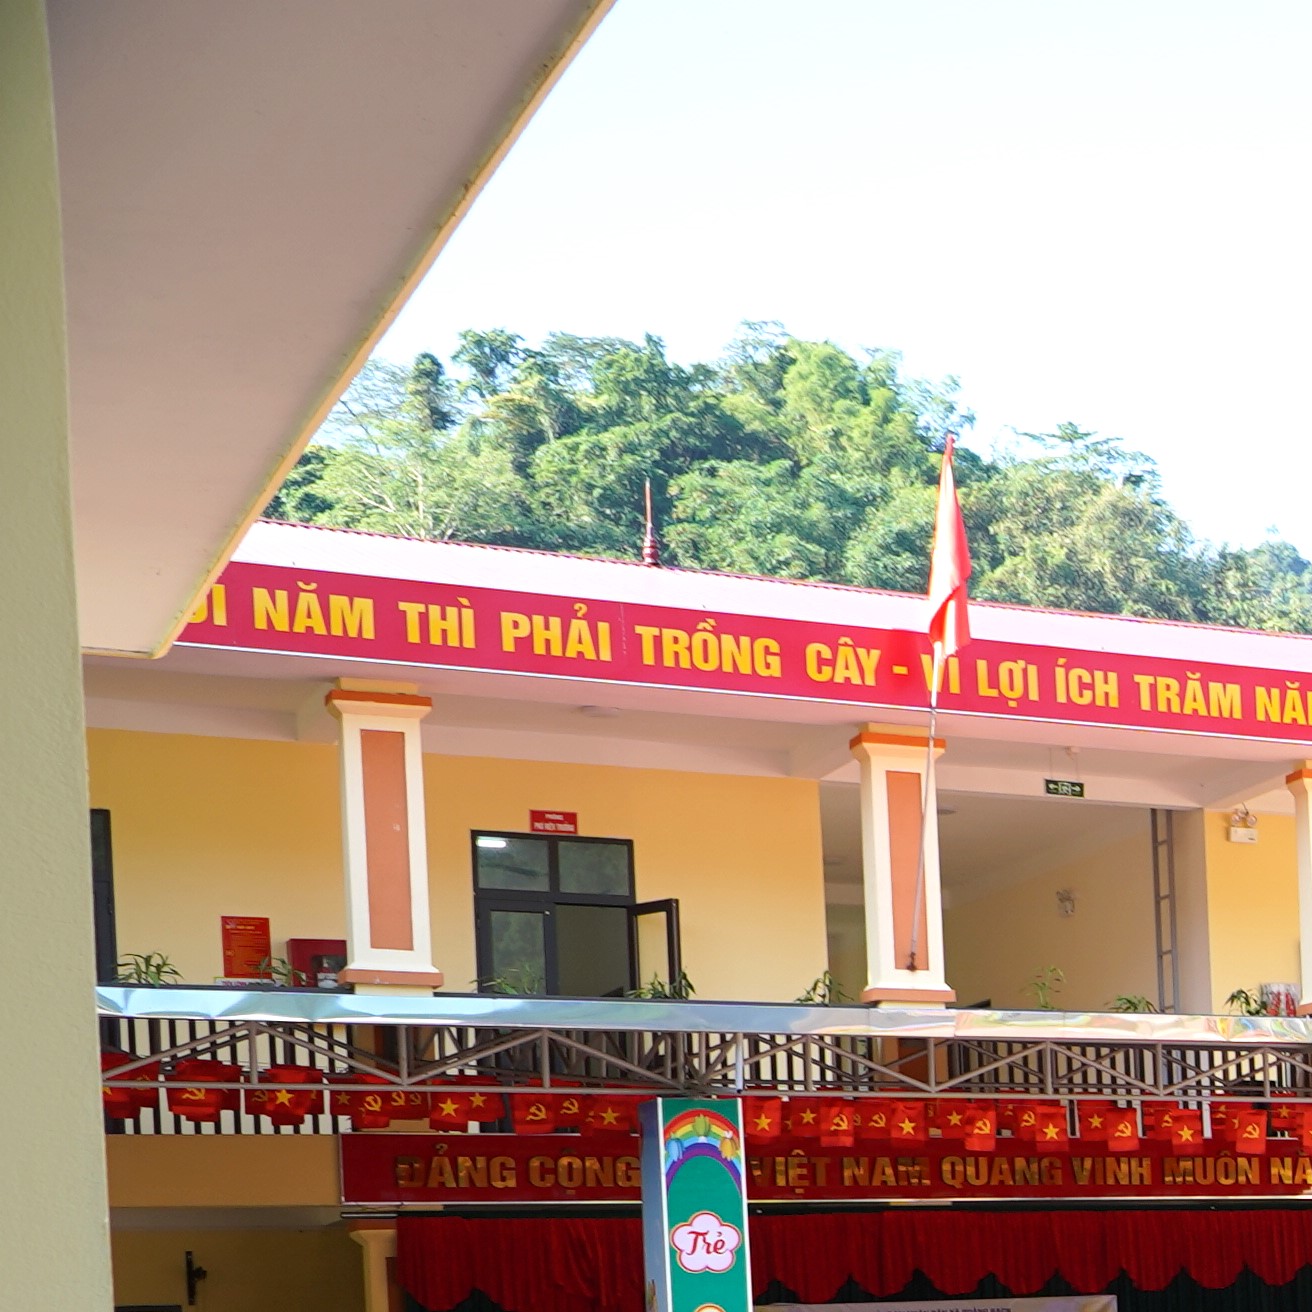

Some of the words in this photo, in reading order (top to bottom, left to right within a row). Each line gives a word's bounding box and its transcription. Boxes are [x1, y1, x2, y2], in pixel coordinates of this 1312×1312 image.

[253, 581, 375, 640] NĂM
[398, 596, 476, 649] THÌ
[500, 603, 612, 662] PHẢI
[635, 618, 782, 678] TRỒNG
[805, 637, 880, 687] CÂY
[975, 659, 1041, 708] LỢI
[1055, 657, 1119, 709] ÍCH
[1134, 674, 1243, 721] TRĂM
[394, 1143, 518, 1190] ĐẢNG
[527, 1148, 640, 1195] CỘNG
[749, 1149, 829, 1194] VIỆT
[842, 1156, 931, 1188] NAM
[941, 1155, 1064, 1190] QUANG
[1071, 1155, 1152, 1187] VINH
[1163, 1148, 1261, 1187] MUÔN
[686, 1230, 727, 1257] Trẻ
